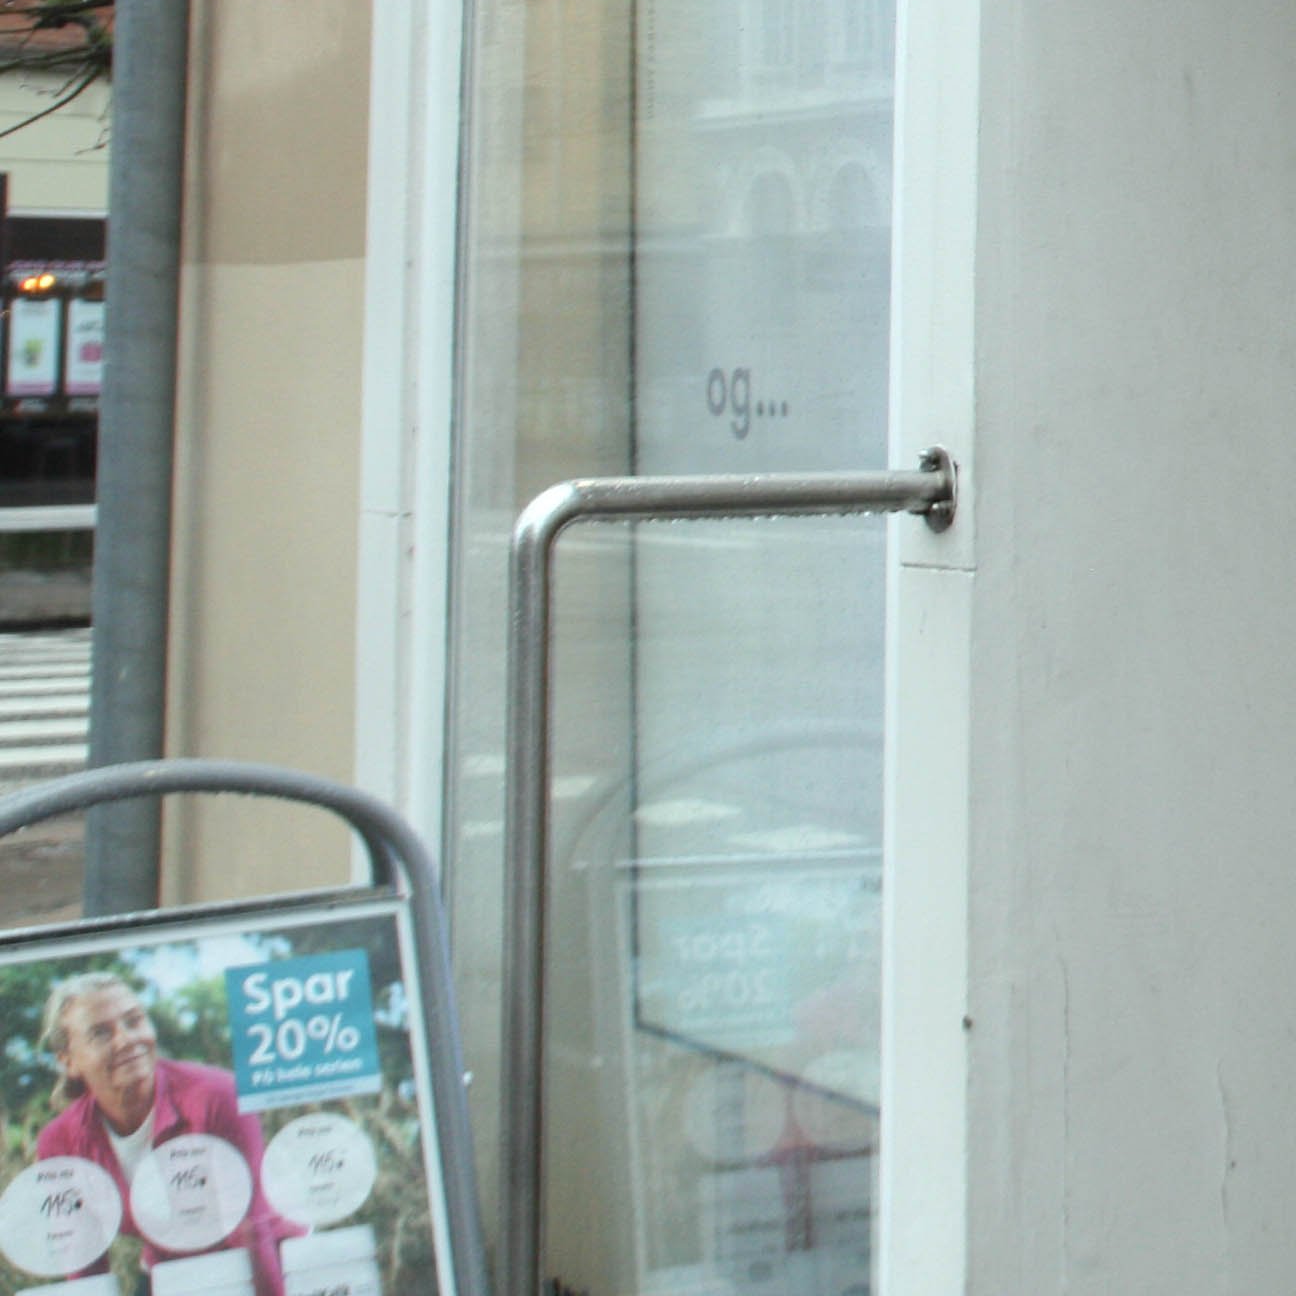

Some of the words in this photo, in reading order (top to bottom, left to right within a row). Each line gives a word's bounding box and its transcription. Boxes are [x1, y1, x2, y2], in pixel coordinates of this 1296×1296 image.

[706, 367, 789, 441] og...
[242, 968, 355, 1021] Spar
[246, 1012, 361, 1066] 20%
